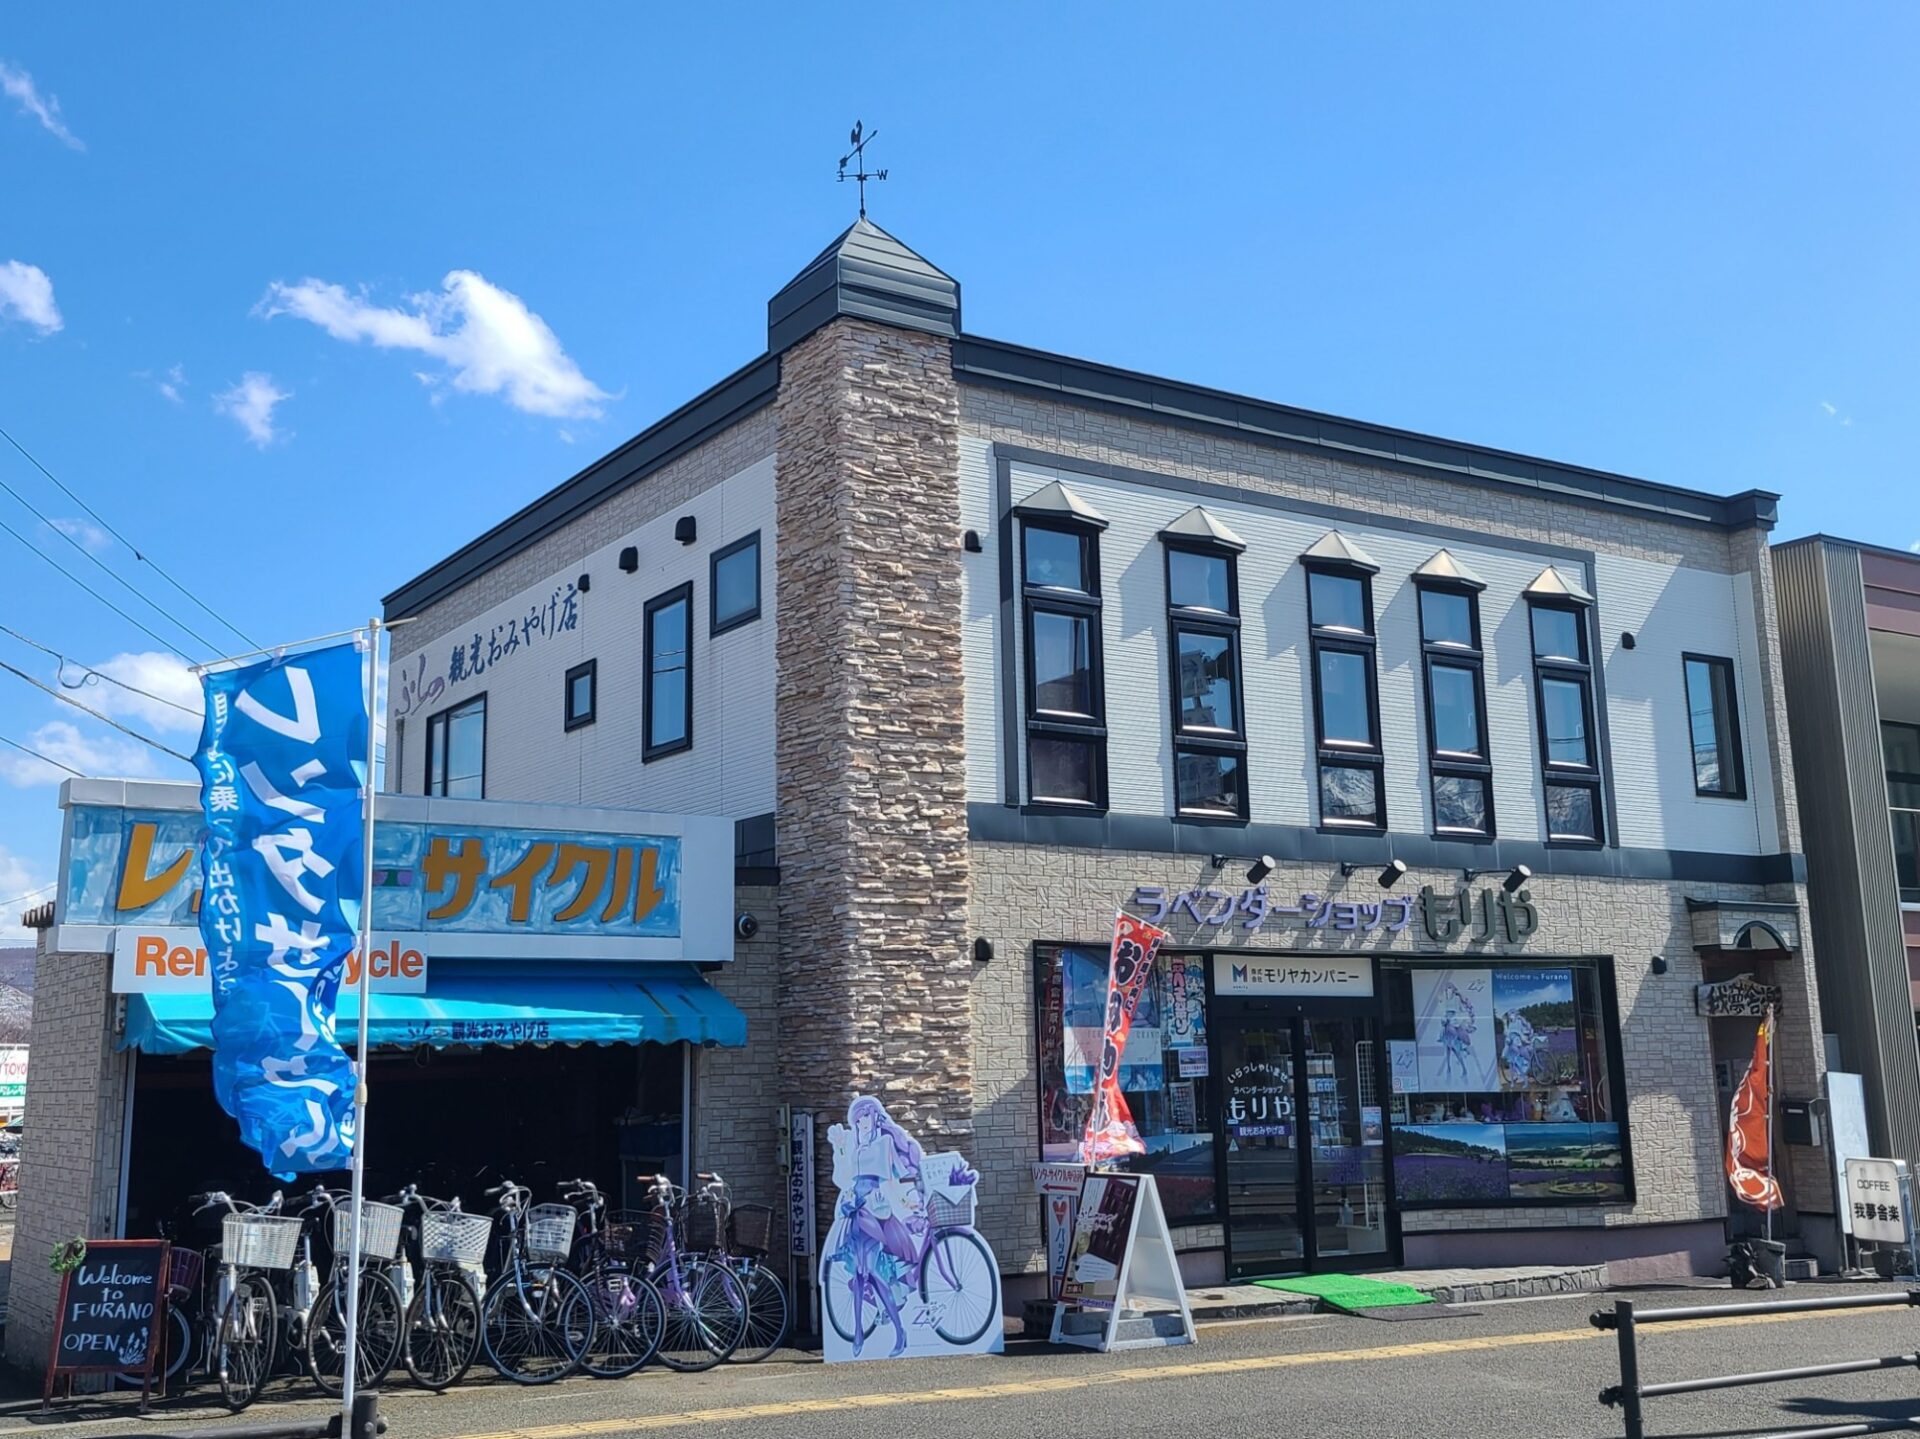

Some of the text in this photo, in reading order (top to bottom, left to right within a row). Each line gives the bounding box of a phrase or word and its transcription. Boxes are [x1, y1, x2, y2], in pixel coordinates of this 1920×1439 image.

[117, 823, 200, 913] レ
[135, 936, 423, 984] Ren ycle
[1495, 973, 1532, 981] Welcome
[1540, 973, 1569, 981] Furano
[1227, 1062, 1289, 1084] いらっしゃいませ
[1230, 1096, 1291, 1120] もりや
[1856, 1179, 1891, 1192] COFFEE
[78, 1264, 152, 1285] Welcome
[101, 1287, 123, 1301] to
[72, 1302, 153, 1321] FURANO
[64, 1333, 120, 1351] OPEN
